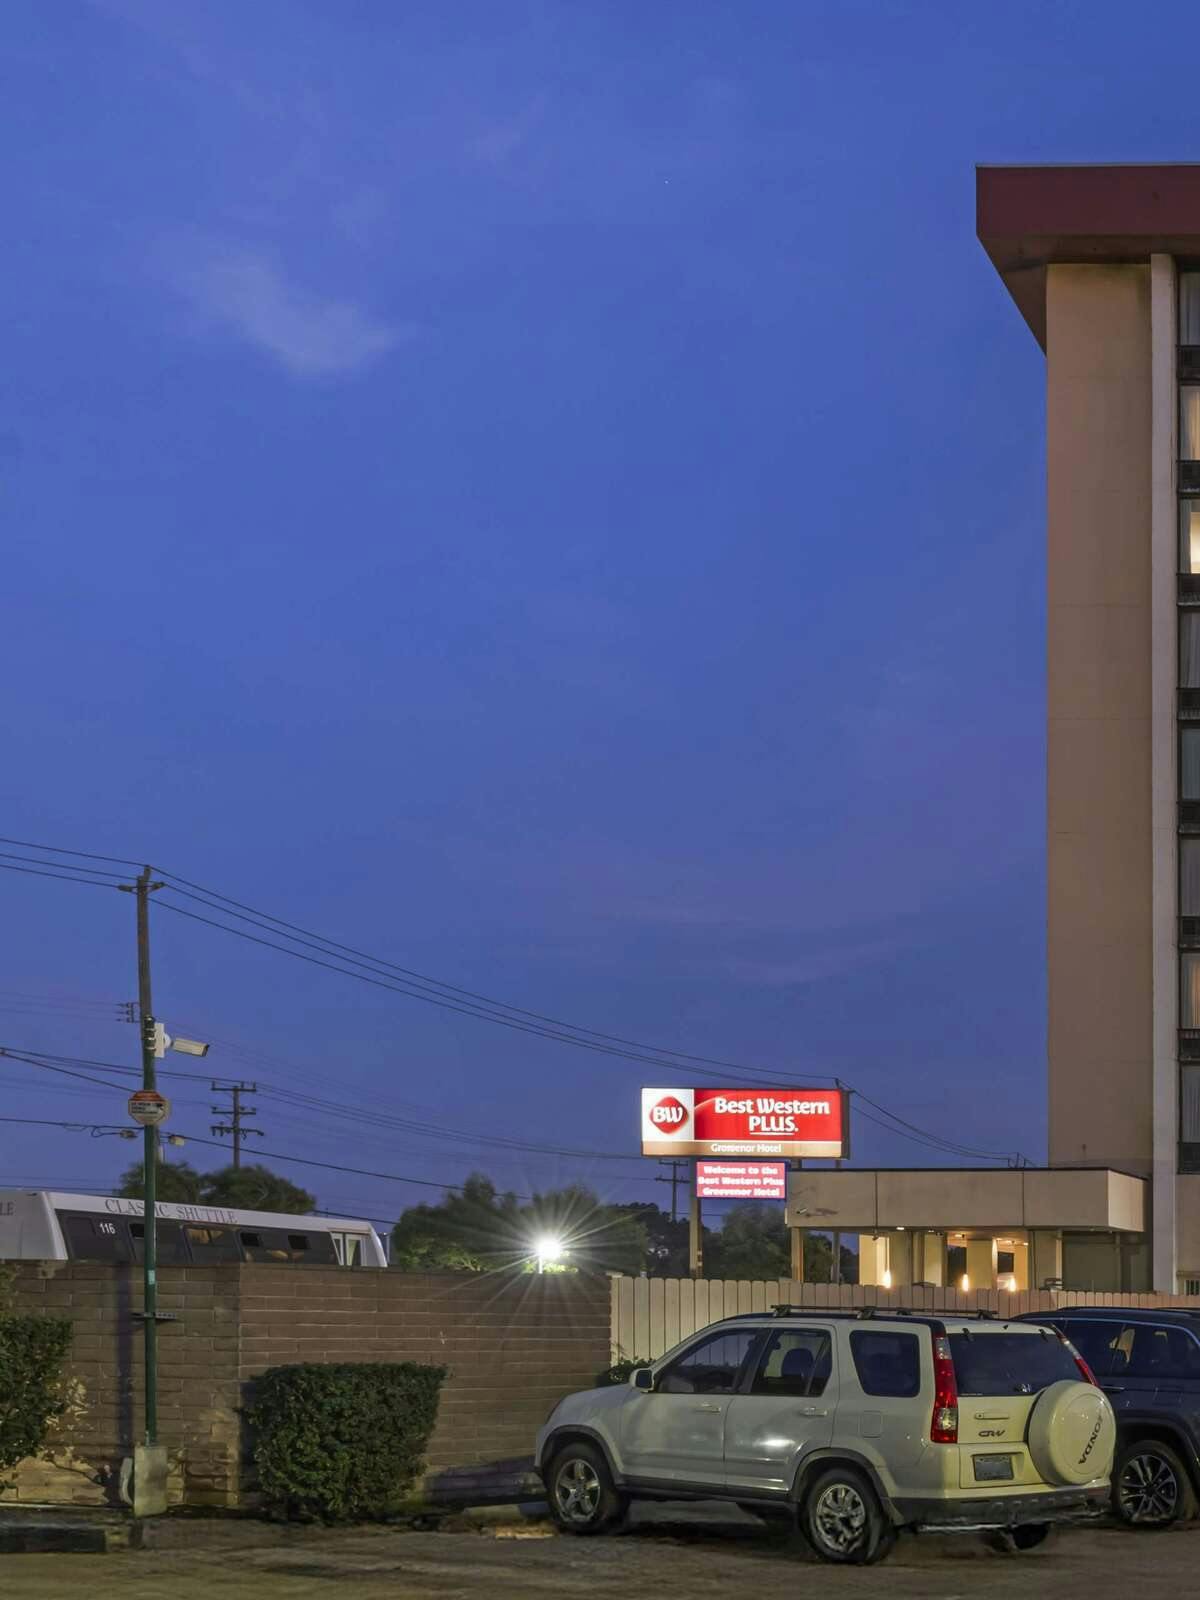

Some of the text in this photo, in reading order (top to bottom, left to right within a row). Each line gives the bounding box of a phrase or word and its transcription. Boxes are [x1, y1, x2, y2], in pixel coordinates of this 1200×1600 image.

[714, 1097, 830, 1115] Best Western
[653, 1106, 684, 1123] BW
[756, 1143, 782, 1153] Hotel
[703, 1165, 778, 1175] Welcome to the
[697, 1176, 785, 1186] Best Western Plus
[753, 1188, 780, 1196] Hotel
[104, 1199, 240, 1224] CLASIC SHUTTLE
